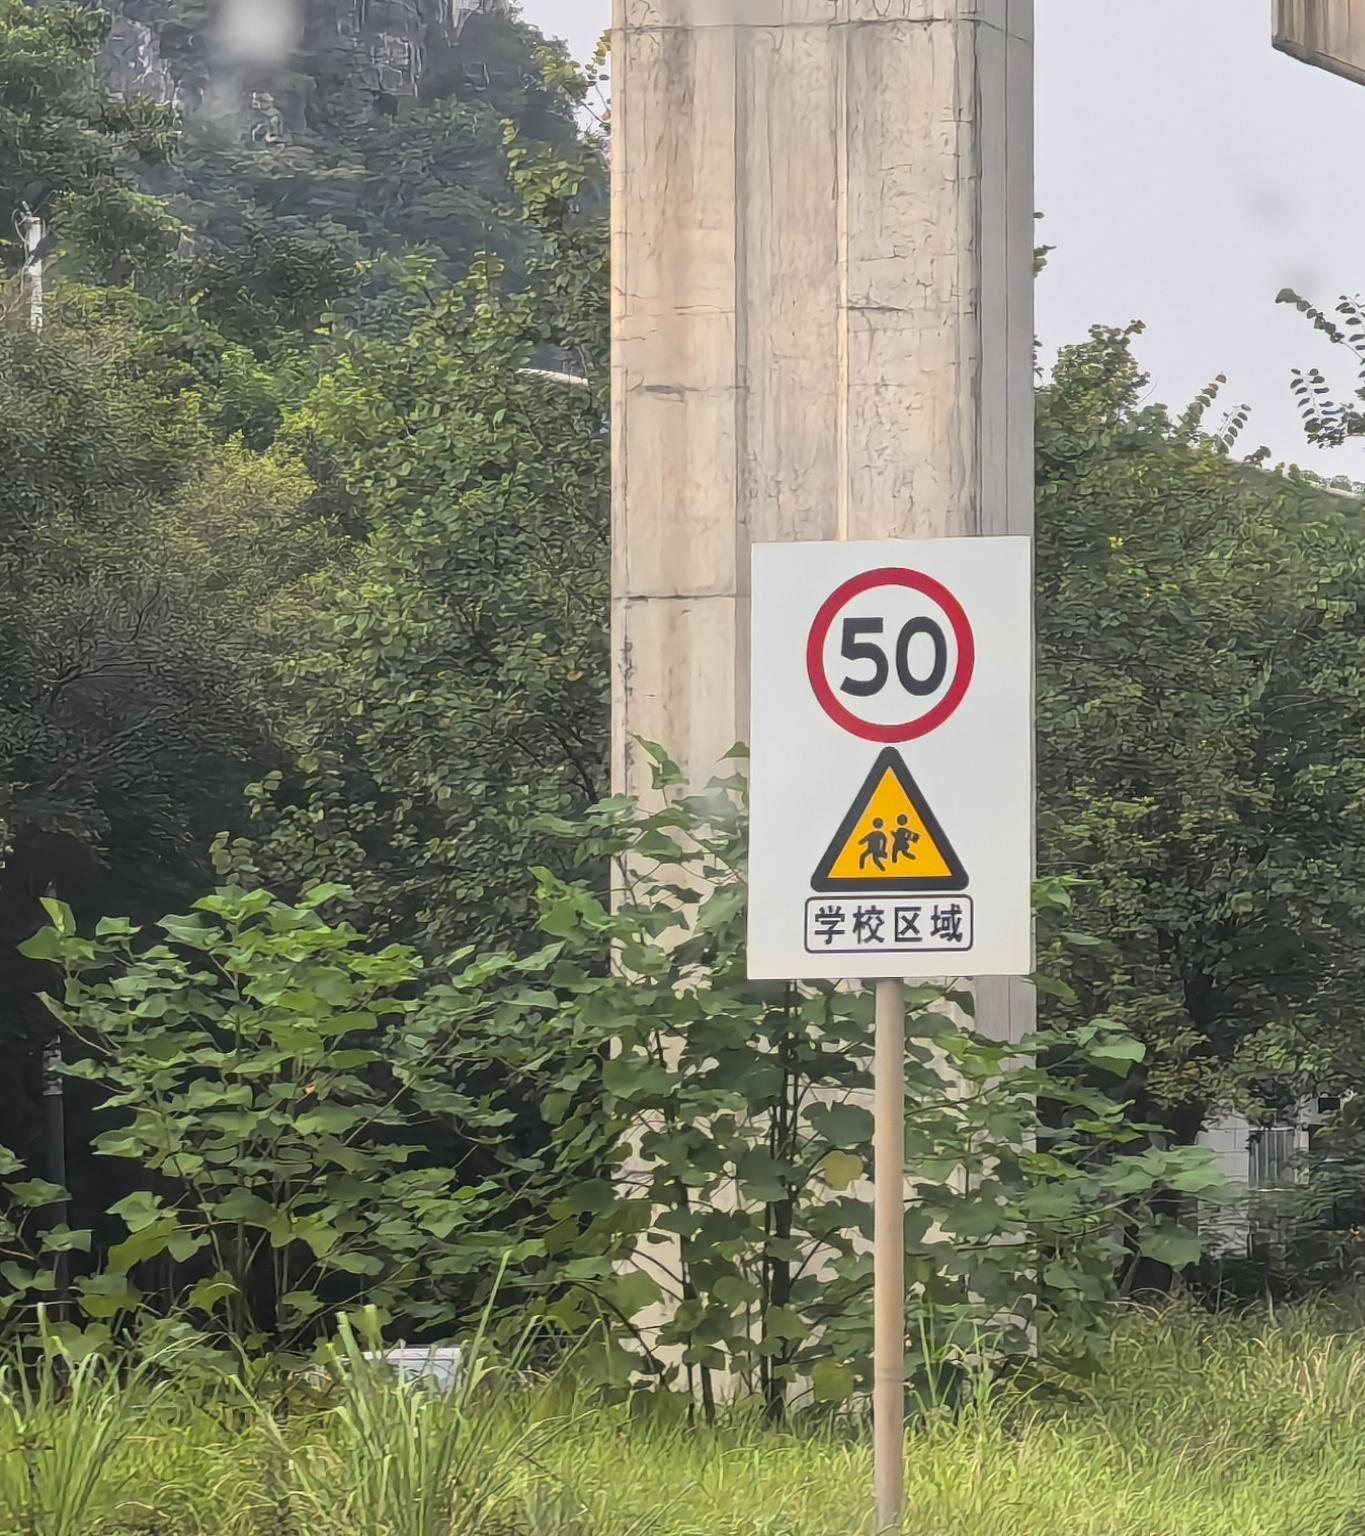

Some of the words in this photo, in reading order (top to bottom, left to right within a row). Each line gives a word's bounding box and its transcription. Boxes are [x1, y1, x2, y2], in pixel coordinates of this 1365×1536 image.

[840, 616, 947, 696] 50
[814, 904, 963, 945] 学校区域
